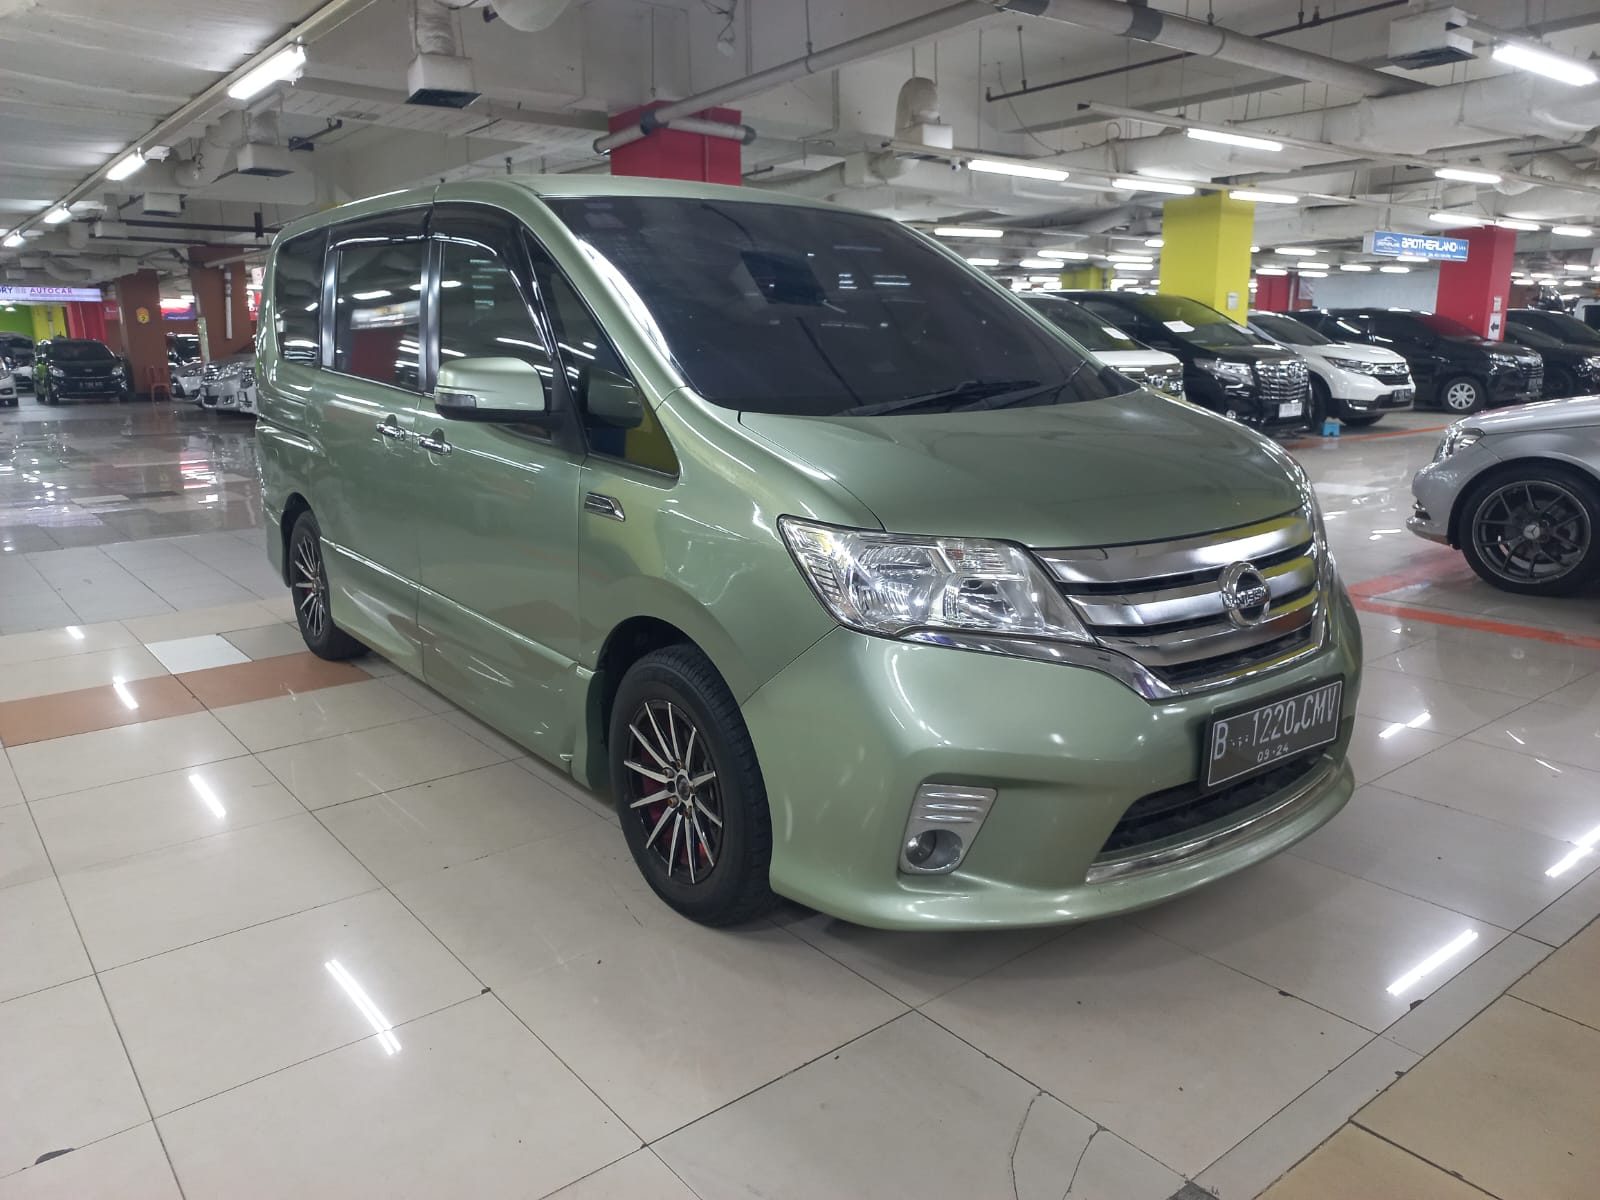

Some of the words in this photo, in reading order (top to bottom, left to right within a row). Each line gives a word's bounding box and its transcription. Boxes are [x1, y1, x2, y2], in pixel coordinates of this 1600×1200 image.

[1401, 237, 1457, 253] BROTHERLAND
[1213, 722, 1229, 761] B
[1252, 701, 1296, 747] 1220
[1301, 685, 1338, 729] CMV
